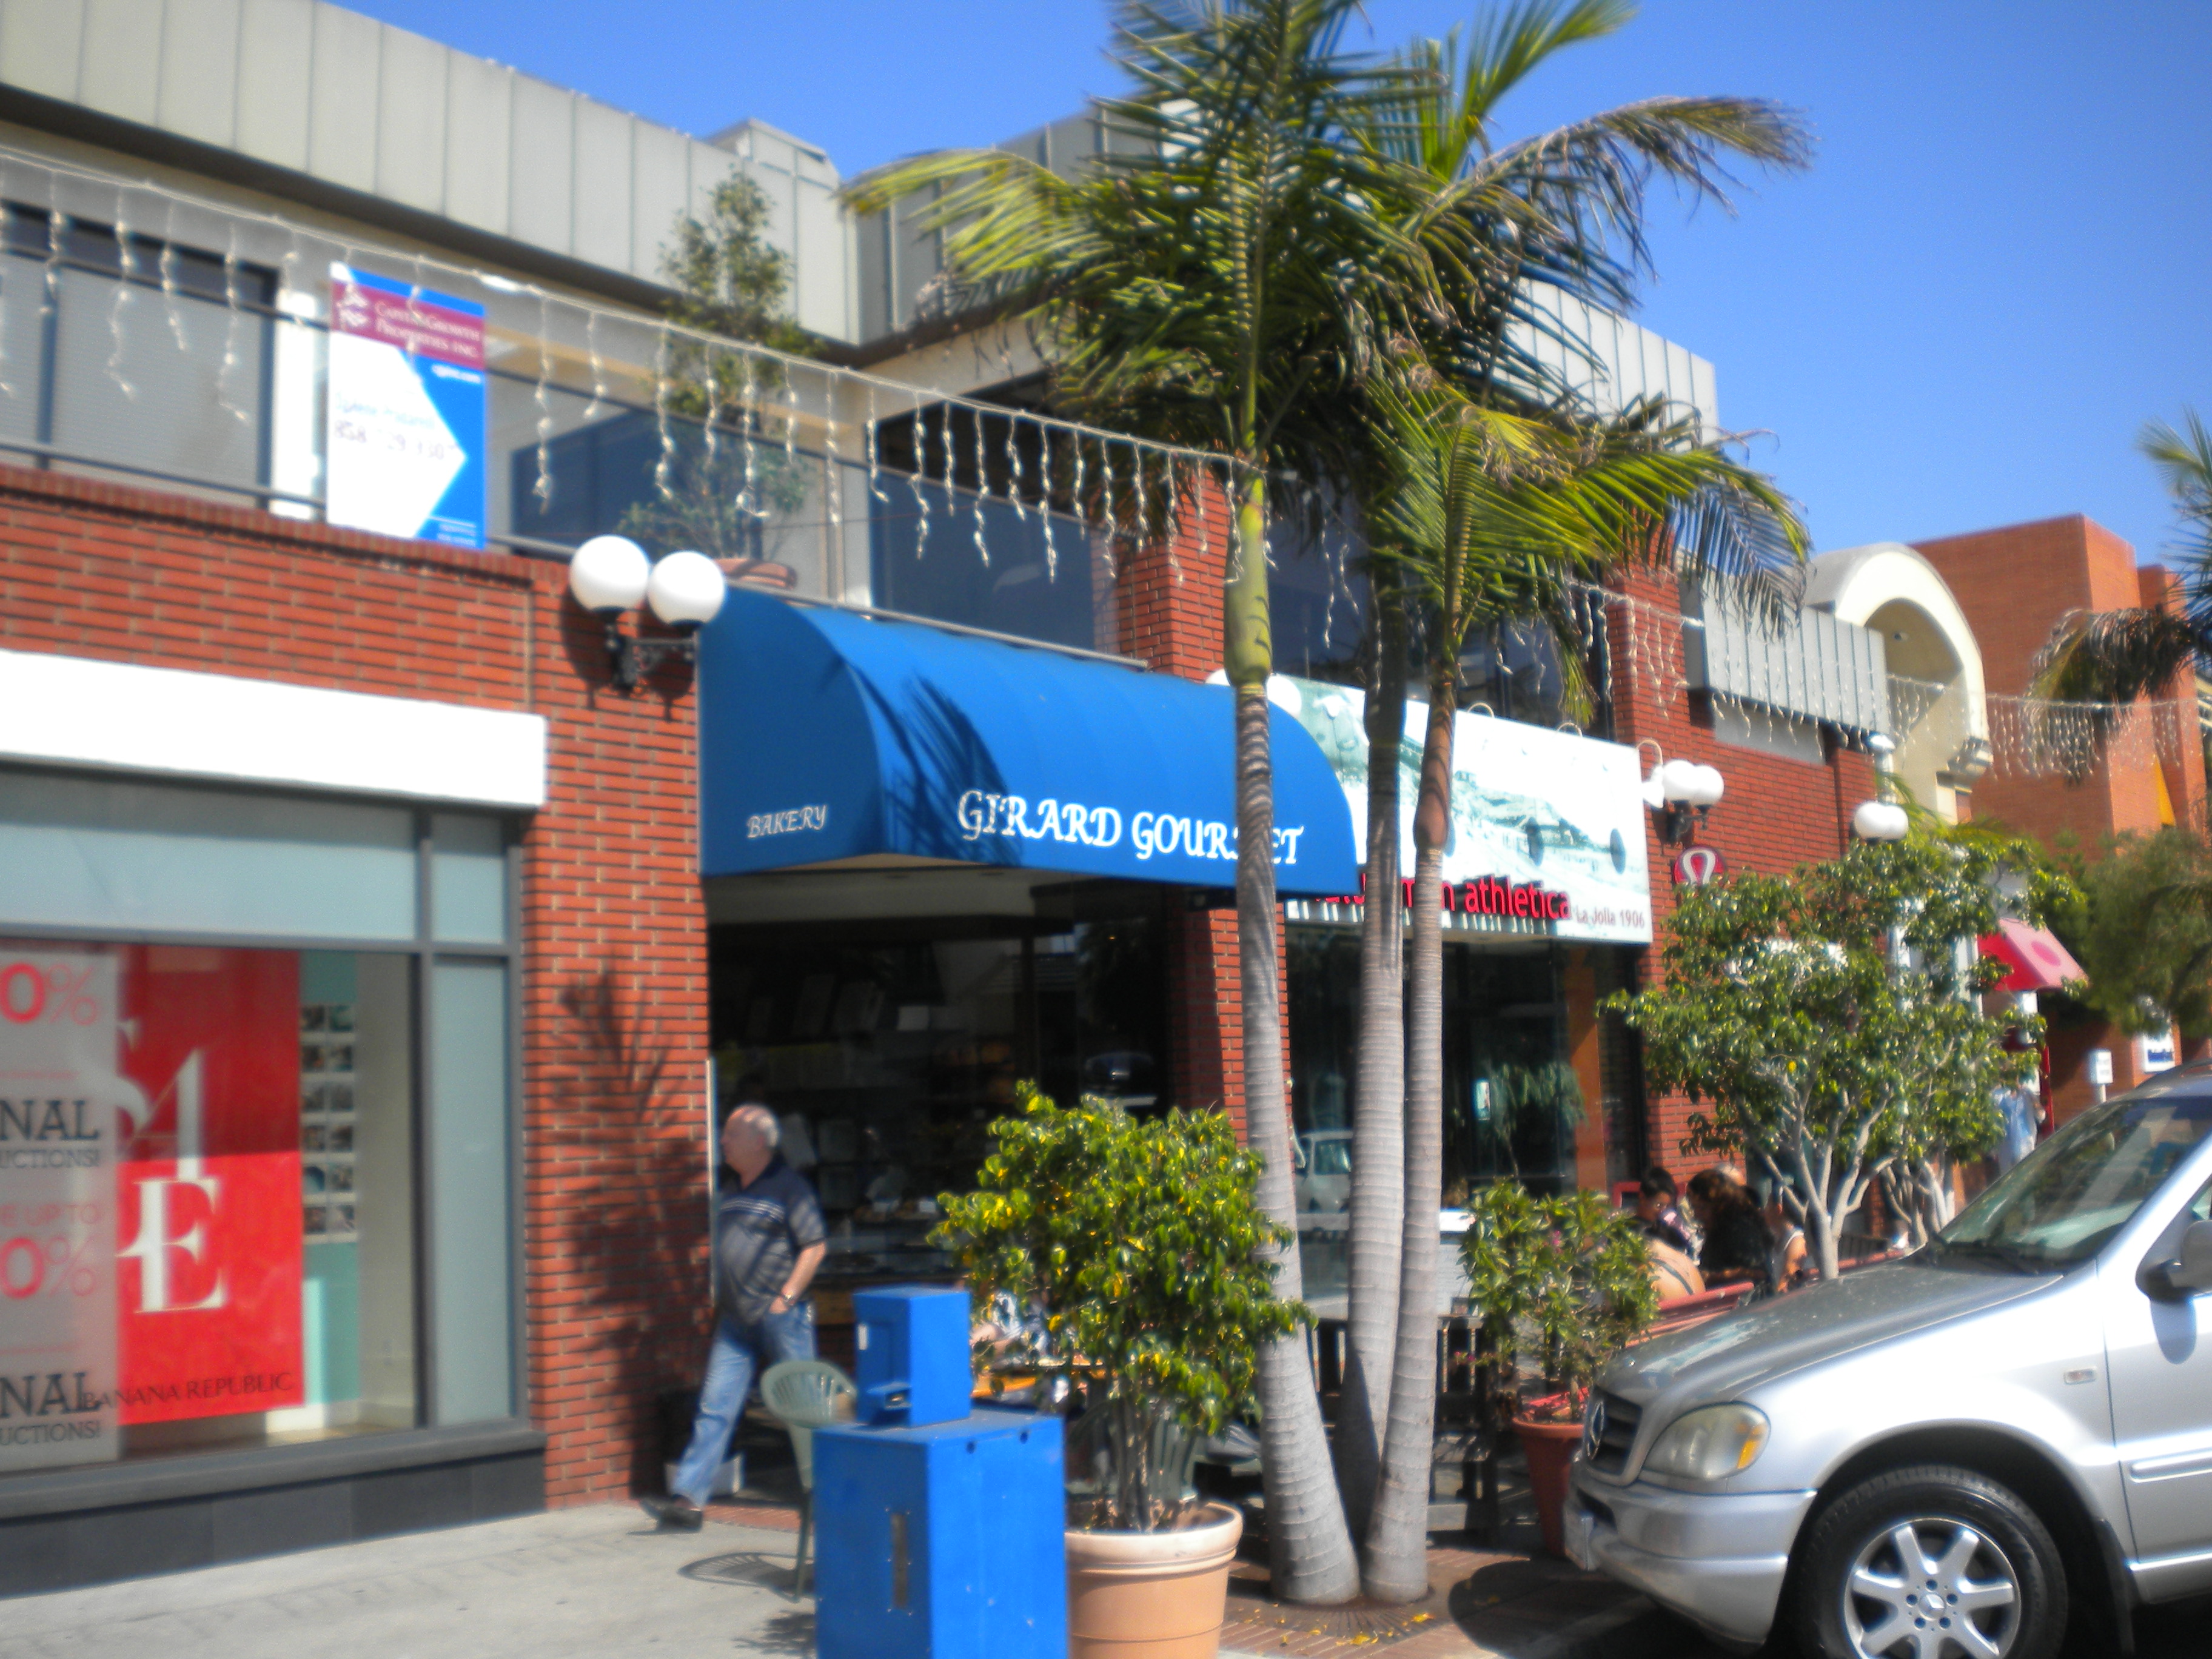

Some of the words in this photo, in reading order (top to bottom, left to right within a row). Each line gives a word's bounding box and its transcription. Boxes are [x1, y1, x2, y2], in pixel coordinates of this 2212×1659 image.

[746, 805, 826, 839] BAKERY
[957, 789, 1122, 847] GIRARD
[1131, 811, 1304, 865] GOURET
[1464, 873, 1570, 920] athletica
[1591, 907, 1616, 927] Jolla
[1620, 910, 1645, 930] 1906
[186, 1372, 293, 1400] REPUBLIC
